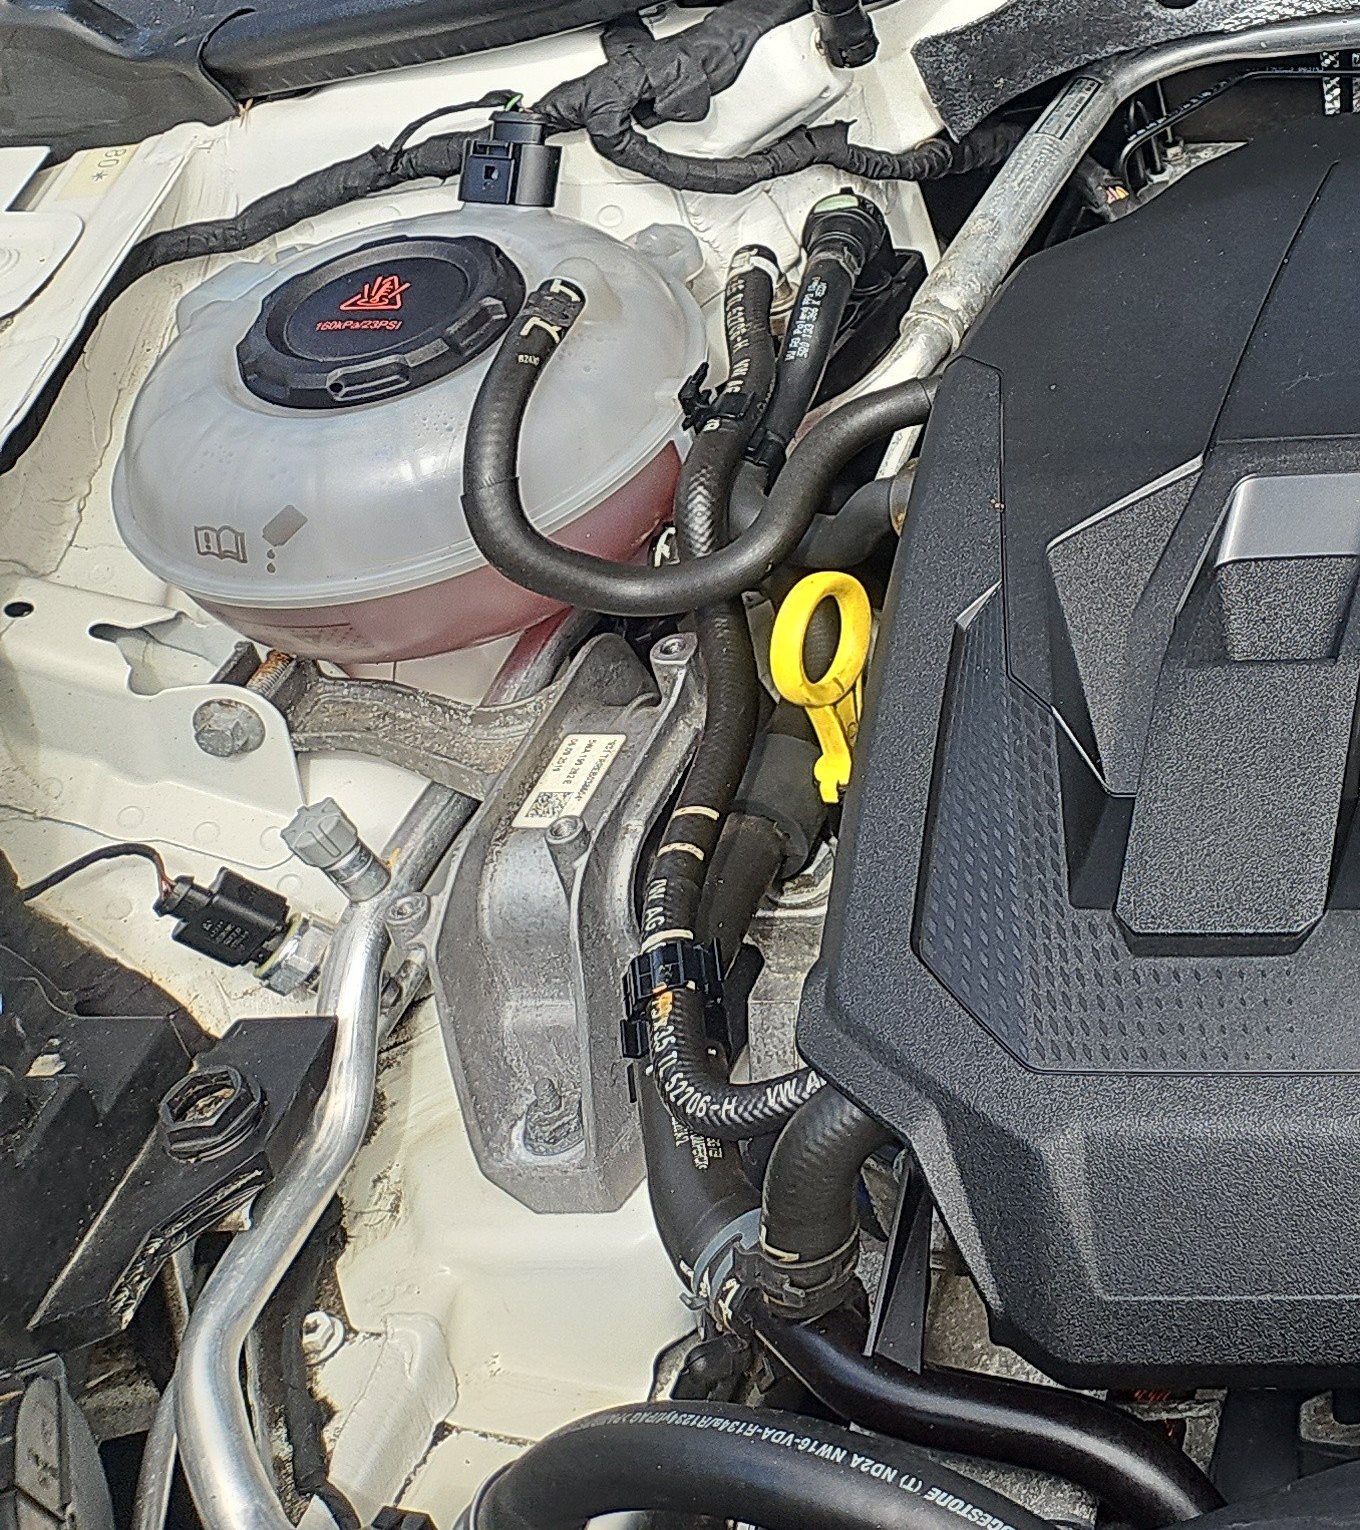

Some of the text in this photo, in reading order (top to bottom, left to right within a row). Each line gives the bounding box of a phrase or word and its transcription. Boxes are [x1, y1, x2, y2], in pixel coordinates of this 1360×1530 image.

[644, 905, 666, 931] AG
[850, 1452, 899, 1484] ND2A
[899, 1473, 924, 1495] (T)
